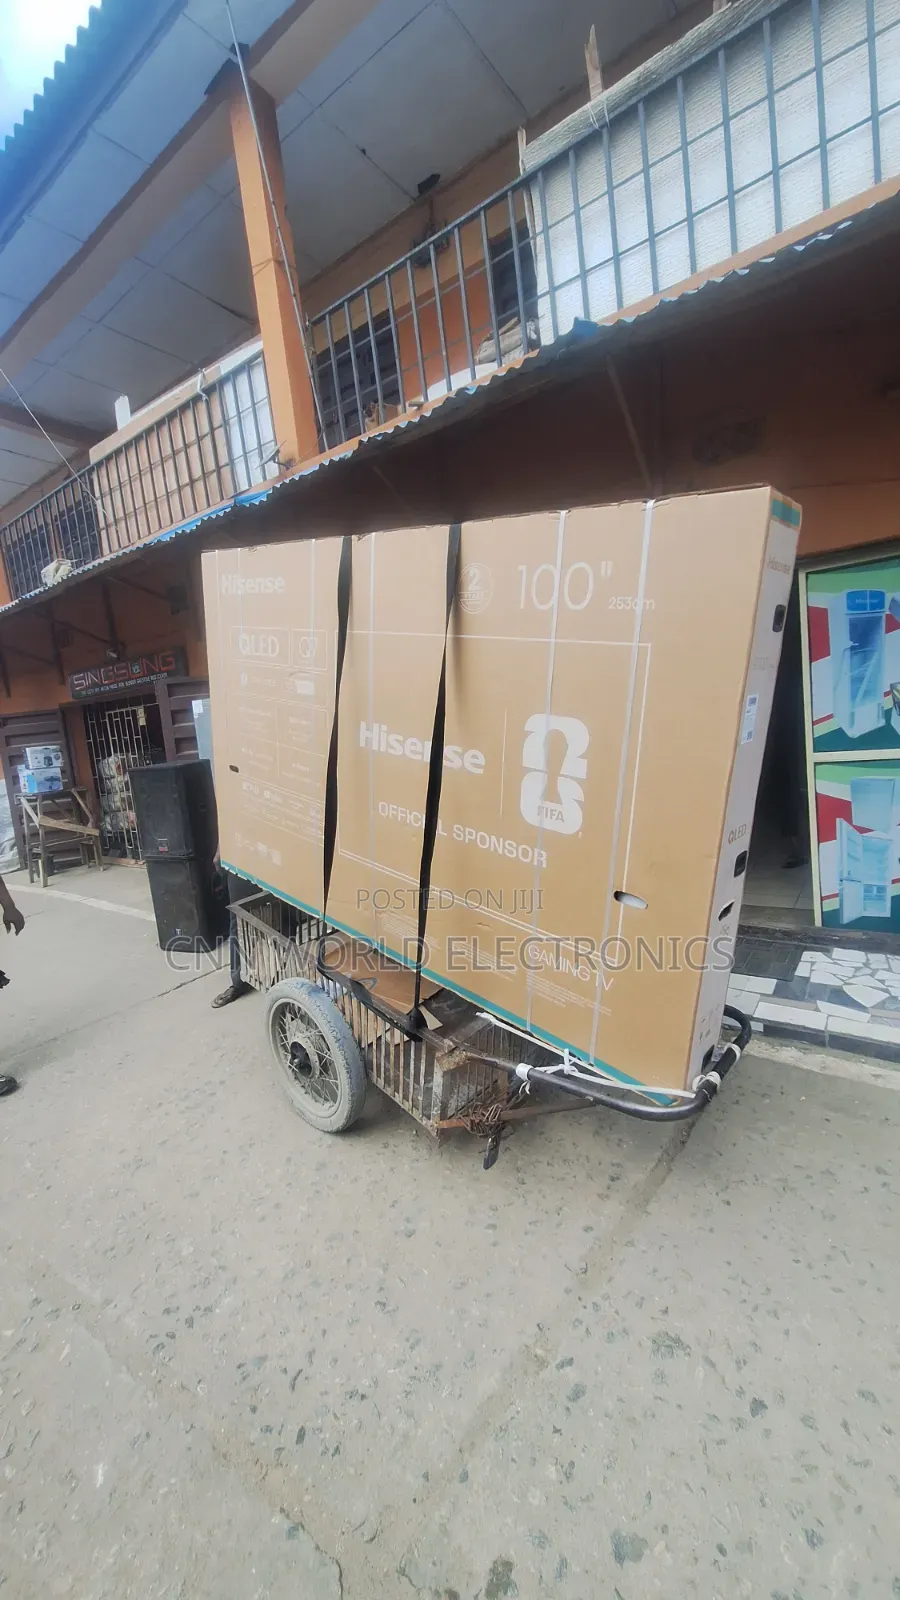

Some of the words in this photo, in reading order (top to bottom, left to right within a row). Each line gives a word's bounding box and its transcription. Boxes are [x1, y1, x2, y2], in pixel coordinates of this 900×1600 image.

[221, 574, 285, 594] Hisense
[467, 567, 482, 590] 2
[238, 633, 280, 658] QLED
[536, 805, 565, 823] FIFA
[378, 801, 448, 836] OFFICIL
[453, 823, 547, 868] SPONSOR
[728, 823, 747, 844] QLED
[528, 943, 591, 982] GAMING
[593, 970, 614, 991] TV
